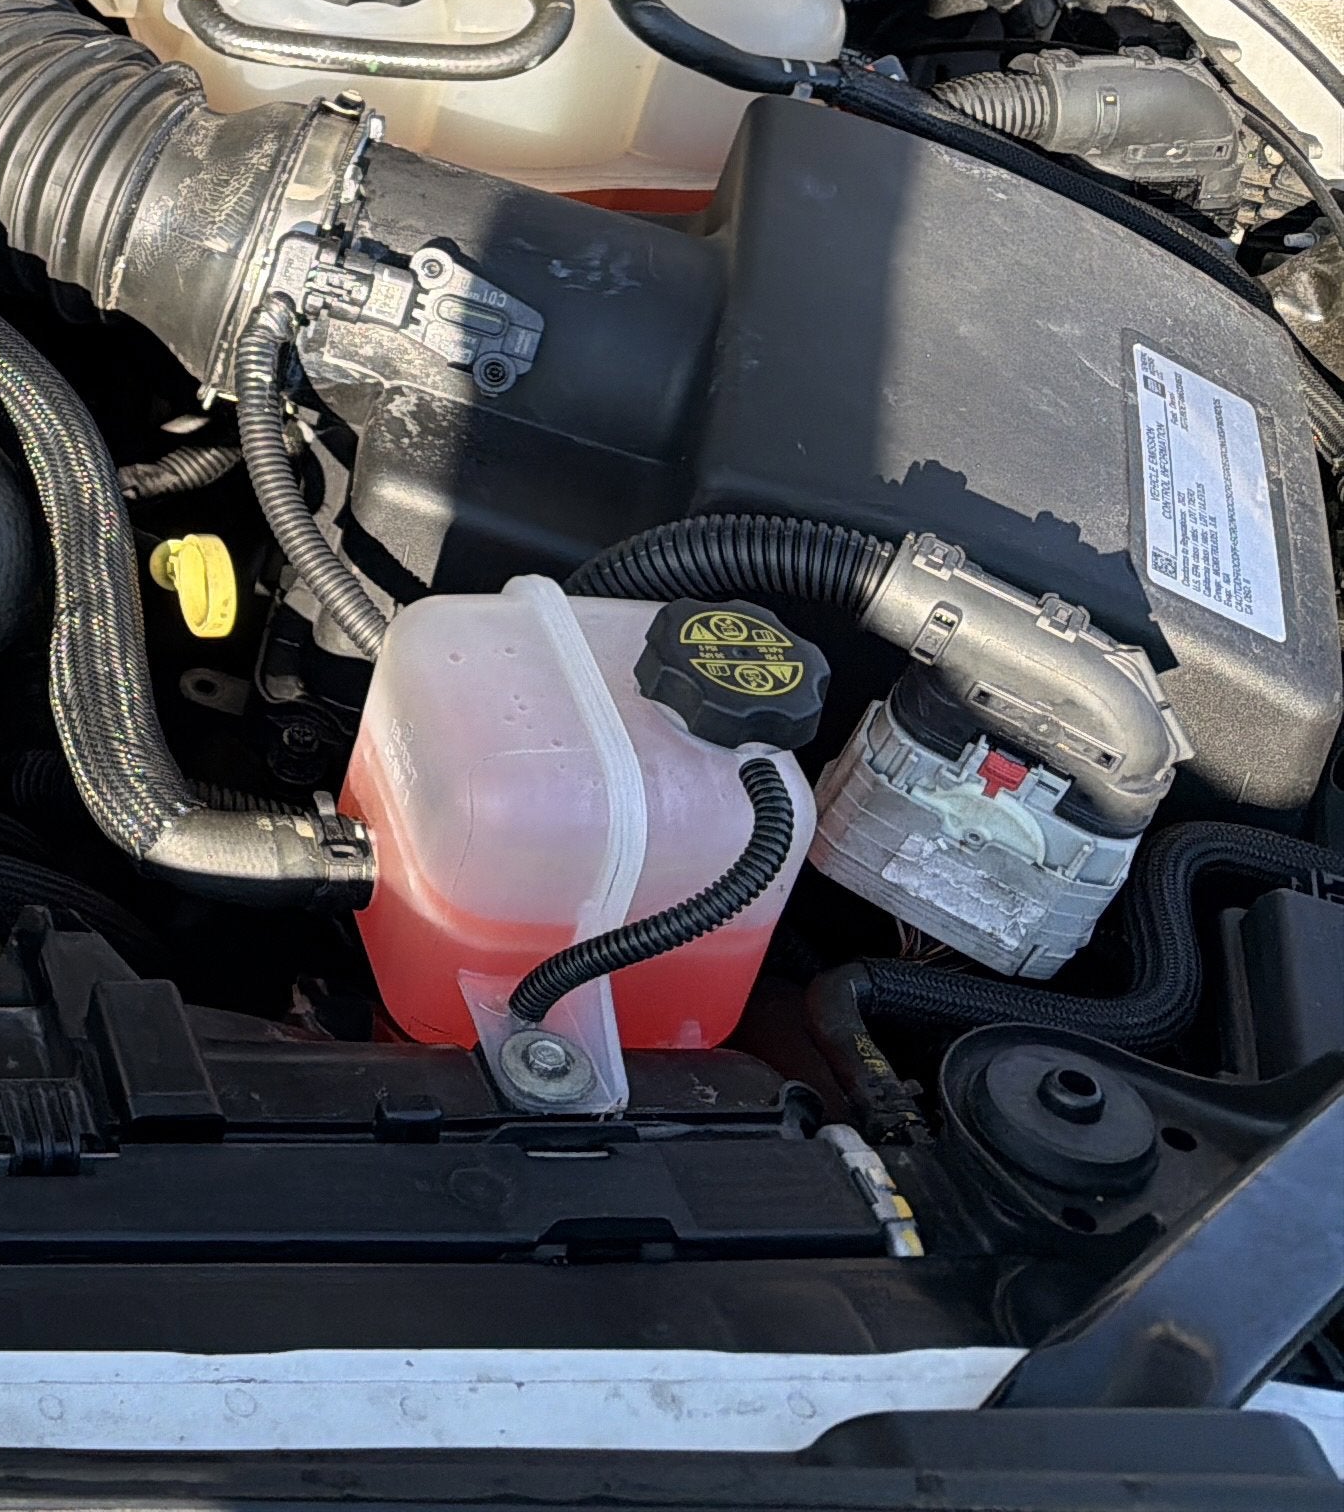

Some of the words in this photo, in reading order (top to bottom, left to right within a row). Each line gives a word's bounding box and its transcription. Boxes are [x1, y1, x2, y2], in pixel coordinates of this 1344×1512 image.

[1146, 425, 1158, 466] EMISSION
[1156, 421, 1169, 478] INFORMATION
[1148, 465, 1160, 501] VEHICLE
[1160, 479, 1172, 520] CONTROL
